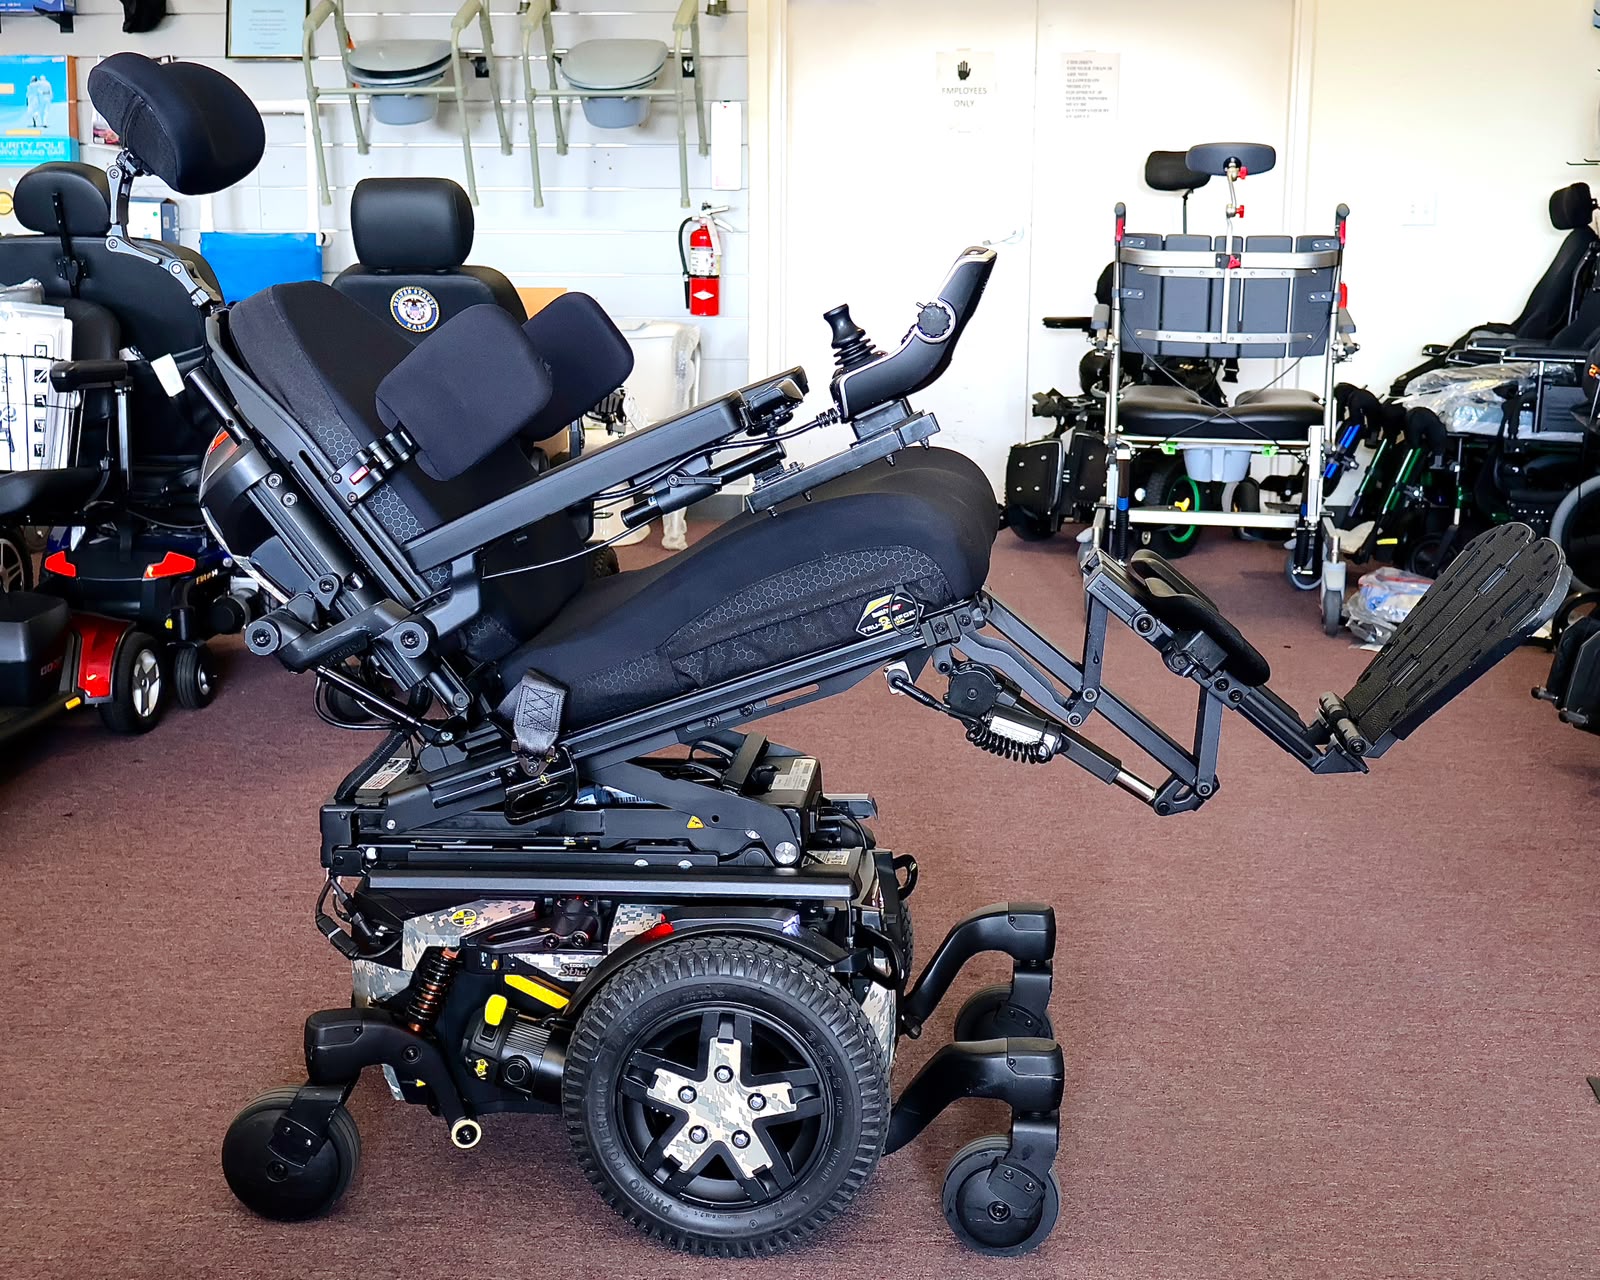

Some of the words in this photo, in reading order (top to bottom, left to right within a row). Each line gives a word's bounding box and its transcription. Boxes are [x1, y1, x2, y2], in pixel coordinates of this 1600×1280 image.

[941, 87, 988, 96] EMPLOYEES
[953, 99, 975, 108] ONLY
[36, 141, 65, 149] POLE
[628, 1178, 673, 1216] PRIMO
